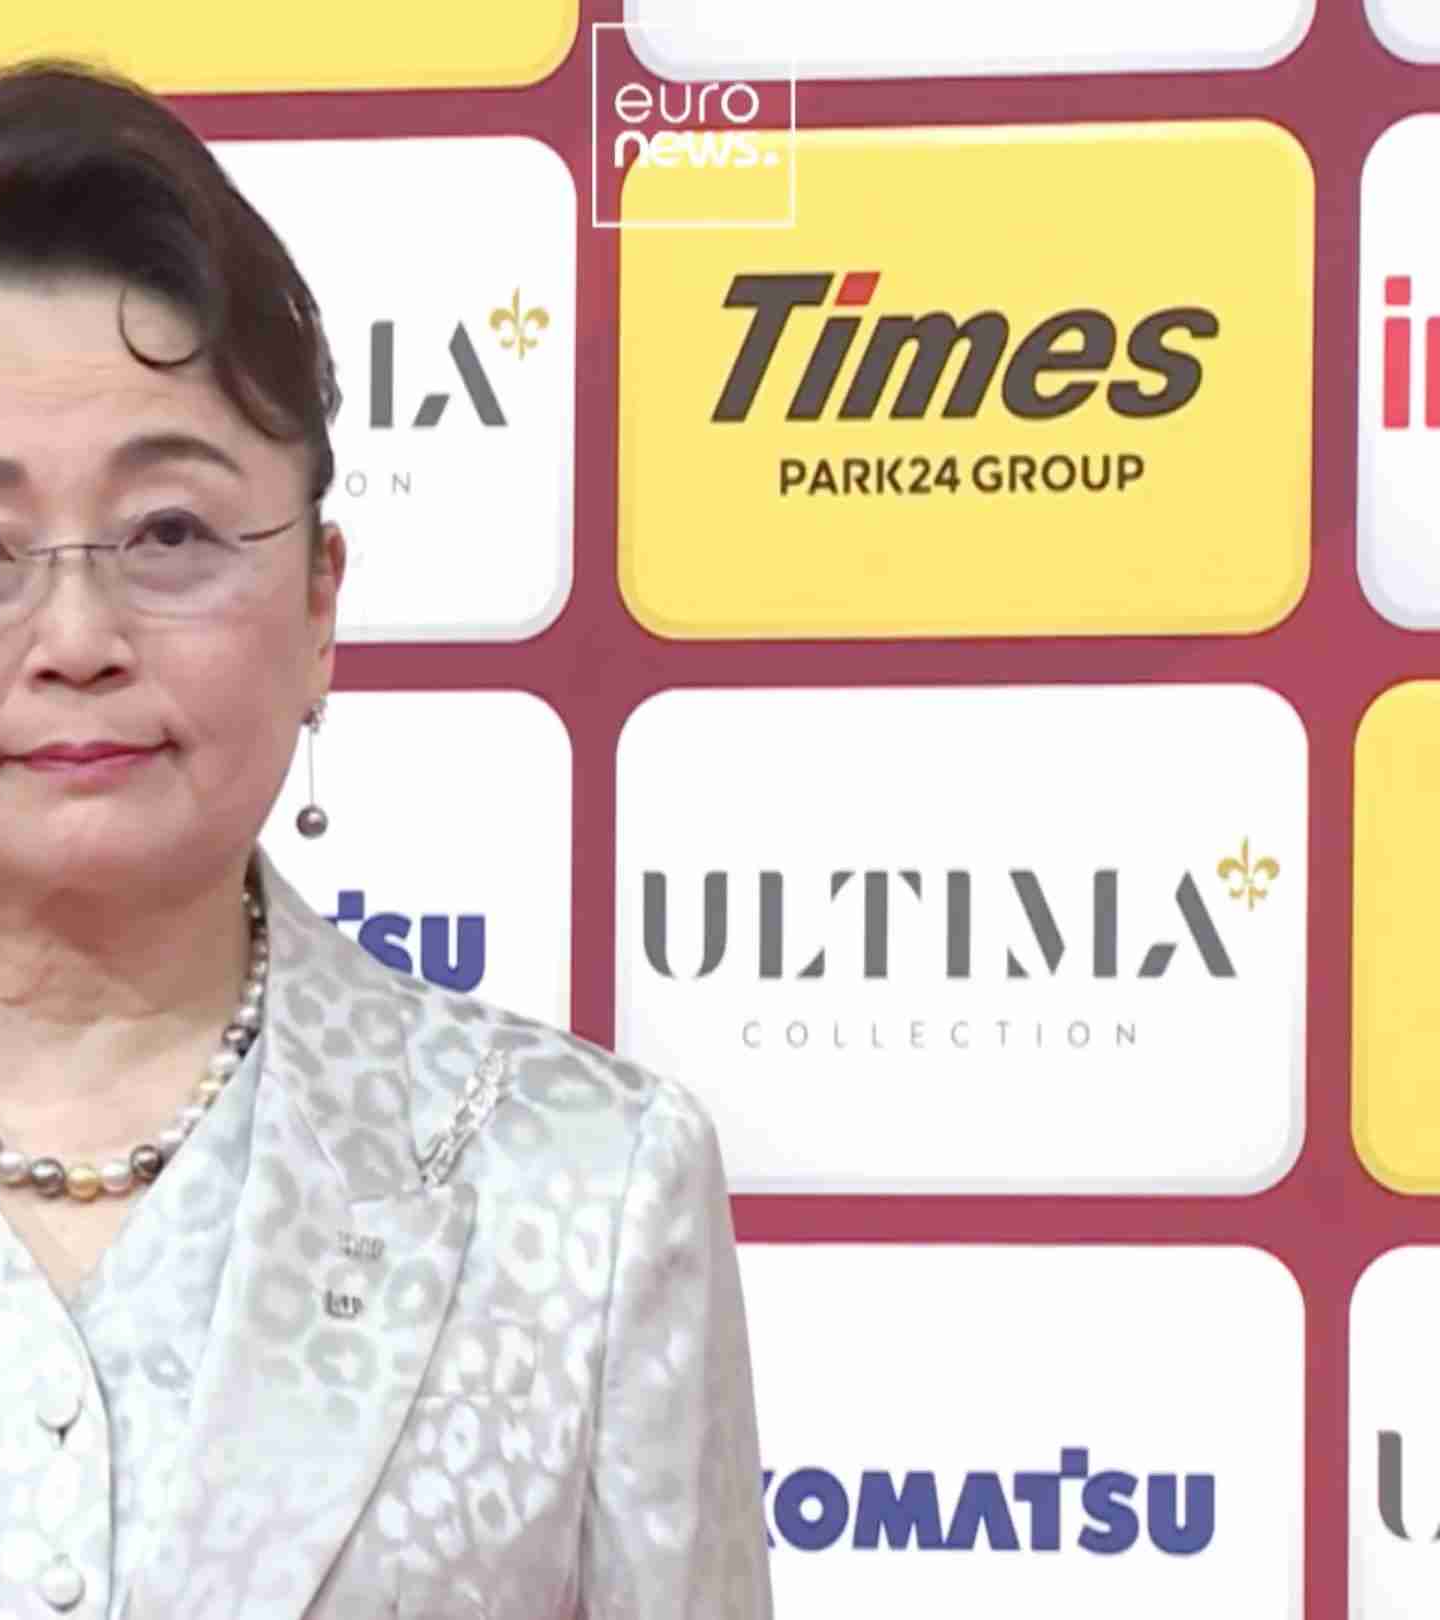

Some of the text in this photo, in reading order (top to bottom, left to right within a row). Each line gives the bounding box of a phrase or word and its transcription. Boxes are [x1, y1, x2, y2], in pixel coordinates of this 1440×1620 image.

[711, 271, 1220, 424] Times
[780, 455, 1146, 496] PARK24 GROUP
[643, 868, 1238, 979] ULTIMA
[741, 1020, 1139, 1049] COLLECTION
